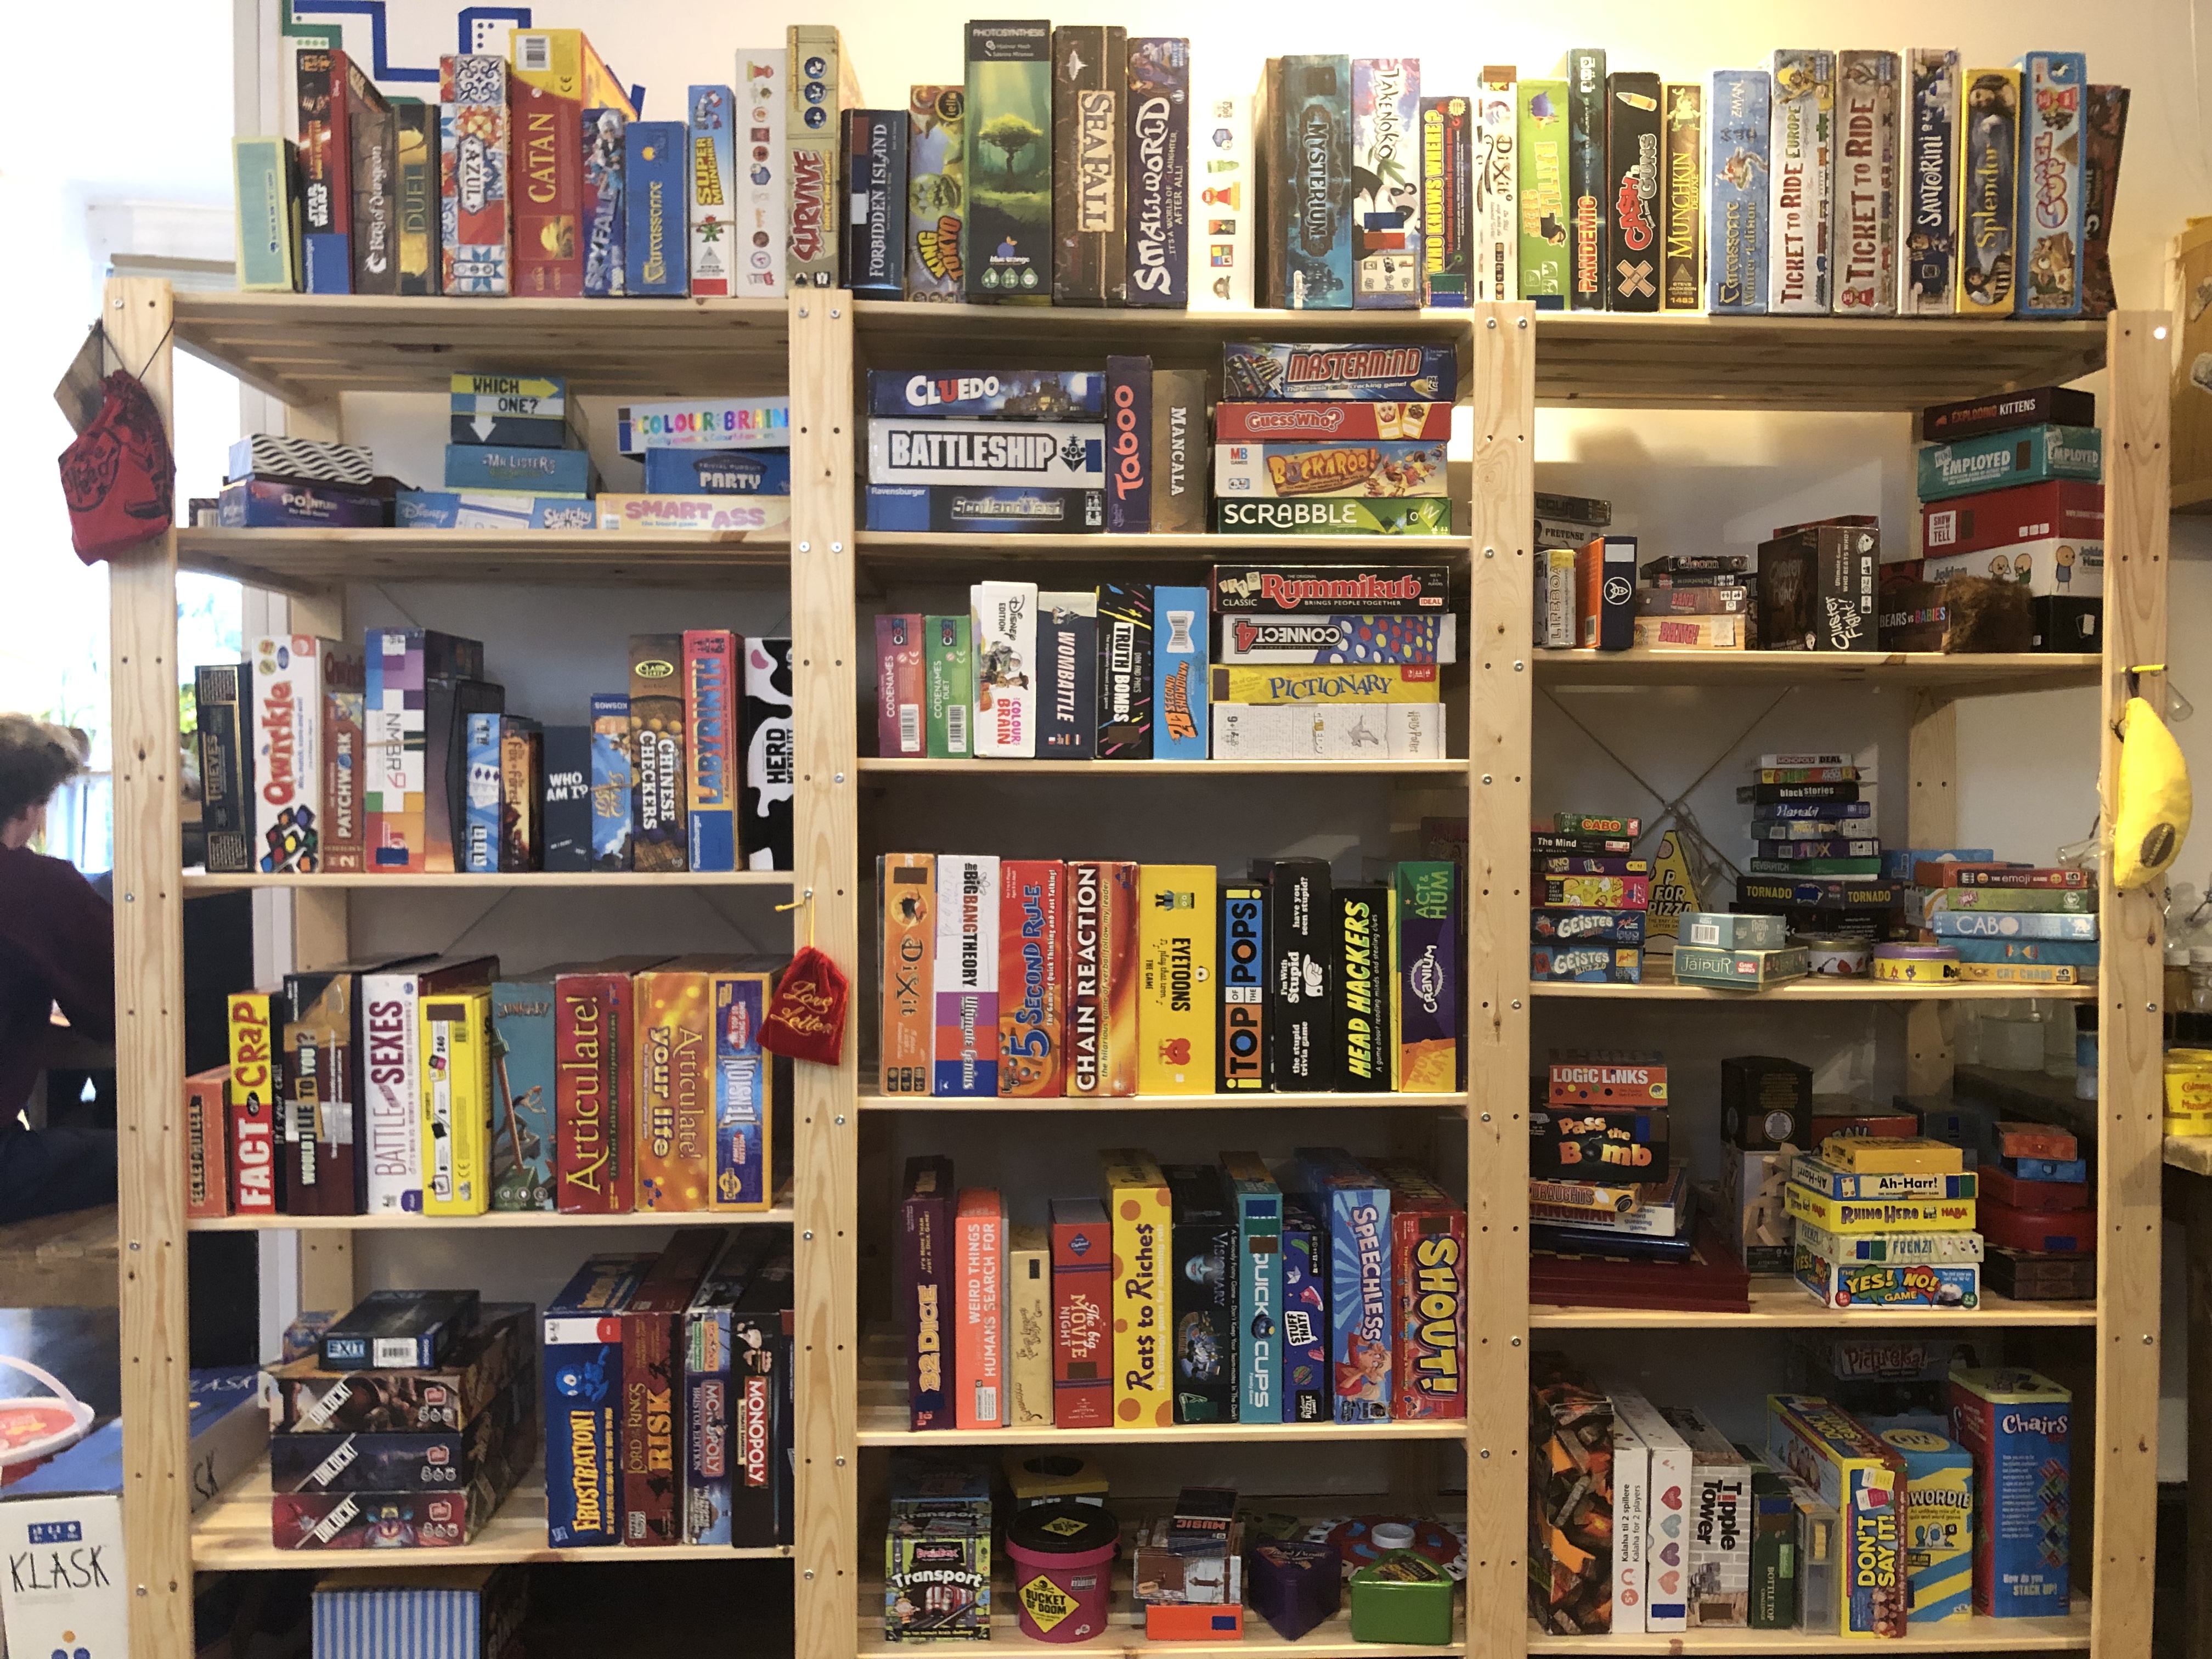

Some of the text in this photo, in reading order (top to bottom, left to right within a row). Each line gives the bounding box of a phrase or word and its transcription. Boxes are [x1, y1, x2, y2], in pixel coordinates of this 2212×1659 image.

[465, 149, 482, 203] AZUL
[528, 112, 556, 203] CATAN
[1081, 92, 1111, 229] SEAFALL
[1308, 123, 1328, 240] MYSTERIUM
[1534, 141, 1562, 217] BATTLE
[869, 125, 889, 277] FORBIDDEN ISLAND
[1425, 110, 1444, 273] WHO KNOWS WHERE?
[1668, 152, 1692, 261] MUNCHKIN
[1781, 105, 1804, 304] TICKET TO RIDE EUROPE
[1845, 99, 1876, 284] TICKET TO RIDE
[1972, 142, 2006, 249] Splendor
[1578, 196, 1598, 292] PANDEMIC
[472, 377, 520, 393] WHICH
[1288, 348, 1422, 382] MASTERMIND
[498, 398, 538, 414] ONE?
[906, 375, 1000, 407] CLUEDO
[1951, 398, 2036, 424] EXPLODING KITTENS
[1114, 385, 1144, 500] Taboo
[1248, 410, 1342, 432] Guess Who?
[891, 433, 1056, 469] BATTLESHIP
[1171, 407, 1187, 496] MANCALA
[1230, 448, 1248, 460] MB
[1943, 450, 2011, 477] EMPLOYED
[699, 472, 761, 490] PARTY
[871, 487, 926, 496] Ravensburger
[625, 500, 766, 529] SMART ASS
[1224, 504, 1357, 528] SCRABBLE
[1544, 528, 1584, 541] PRETENSE
[1933, 530, 1951, 543] TELL
[1261, 573, 1421, 609] Rummikub
[1236, 623, 1340, 652] CONNECT 4
[1658, 621, 1700, 645] BANG!
[886, 656, 895, 718] CODENAMES
[934, 661, 942, 719] CODENAMES
[1057, 631, 1075, 723] WOMBATTLE
[1114, 626, 1131, 723] TRUTH BOMBS
[1269, 674, 1393, 700] PICTIONARY
[691, 657, 724, 805] LABYRINTH
[997, 698, 1011, 744] BRAIN
[549, 771, 583, 787] WHO
[639, 730, 657, 830] CHECKERS
[658, 739, 675, 821] CHINESE
[766, 728, 786, 784] HERD
[1538, 837, 1577, 848] The Mind
[1582, 820, 1621, 832] CABO
[1048, 870, 1057, 898] Talking!
[1301, 877, 1310, 912] stupid?
[1430, 871, 1449, 919] HUM
[1655, 887, 1686, 902] FOR
[1746, 885, 1792, 899] TORNADO
[1848, 890, 1891, 902] TORNADO
[1047, 929, 1056, 958] Thinking
[1231, 903, 1258, 983] POPS
[1009, 885, 1050, 1058] 5 SECOND RULE
[1047, 960, 1056, 979] Quick
[1047, 980, 1054, 988] of
[1076, 868, 1097, 1091] CHAIN REACTION
[1171, 938, 1191, 1012] EYETOONS
[1287, 950, 1301, 1004] Stupid
[1344, 901, 1372, 1079] HEAD HACKERS
[783, 980, 833, 1014] Love
[1047, 990, 1055, 1009] Game
[369, 1000, 405, 1085] SEXES
[1229, 1006, 1258, 1075] TOP
[1292, 1024, 1301, 1054] stupid
[562, 996, 600, 1194] Articulate!
[649, 1027, 675, 1158] your life
[673, 1027, 705, 1160] Articulate!
[724, 1058, 757, 1125] TENSION
[1552, 1068, 1649, 1085] LOGIC LINKS
[374, 1106, 407, 1177] BATTLE
[1557, 1117, 1607, 1135] Pass
[1607, 1127, 1631, 1141] the
[238, 1119, 272, 1207] FACT
[1879, 1177, 1938, 1189] Ah-Harr!
[1841, 1205, 1920, 1224] RHINO HERO
[1941, 1207, 1968, 1219] HABA
[1893, 1240, 1933, 1255] FRENZI
[968, 1223, 981, 1324] WEIRD THINGS
[1351, 1205, 1385, 1342] SPEECHLESS
[1846, 1269, 1940, 1293] YES! NO!
[1884, 1290, 1918, 1302] GAME
[983, 1223, 997, 1377] HUMANS SEARCH FOR
[1125, 1223, 1156, 1391] Rats to Riches
[1417, 1236, 1460, 1395] SHOUT!
[1058, 1306, 1071, 1348] NIGHT
[1070, 1294, 1088, 1359] MOVIE
[1285, 1312, 1301, 1345] STUFF
[1253, 1340, 1270, 1408] CUPS
[646, 1387, 673, 1471] RISK
[748, 1380, 765, 1482] MONOPOLY
[1697, 1479, 1723, 1546] Tower
[1717, 1481, 1743, 1552] Tipple
[9, 1545, 110, 1593] KLASK
[1856, 1515, 1877, 1587] DON'T
[1877, 1515, 1896, 1587] SAY IT!
[891, 1569, 984, 1588] Transport
[1025, 1587, 1066, 1606] BUCKET
